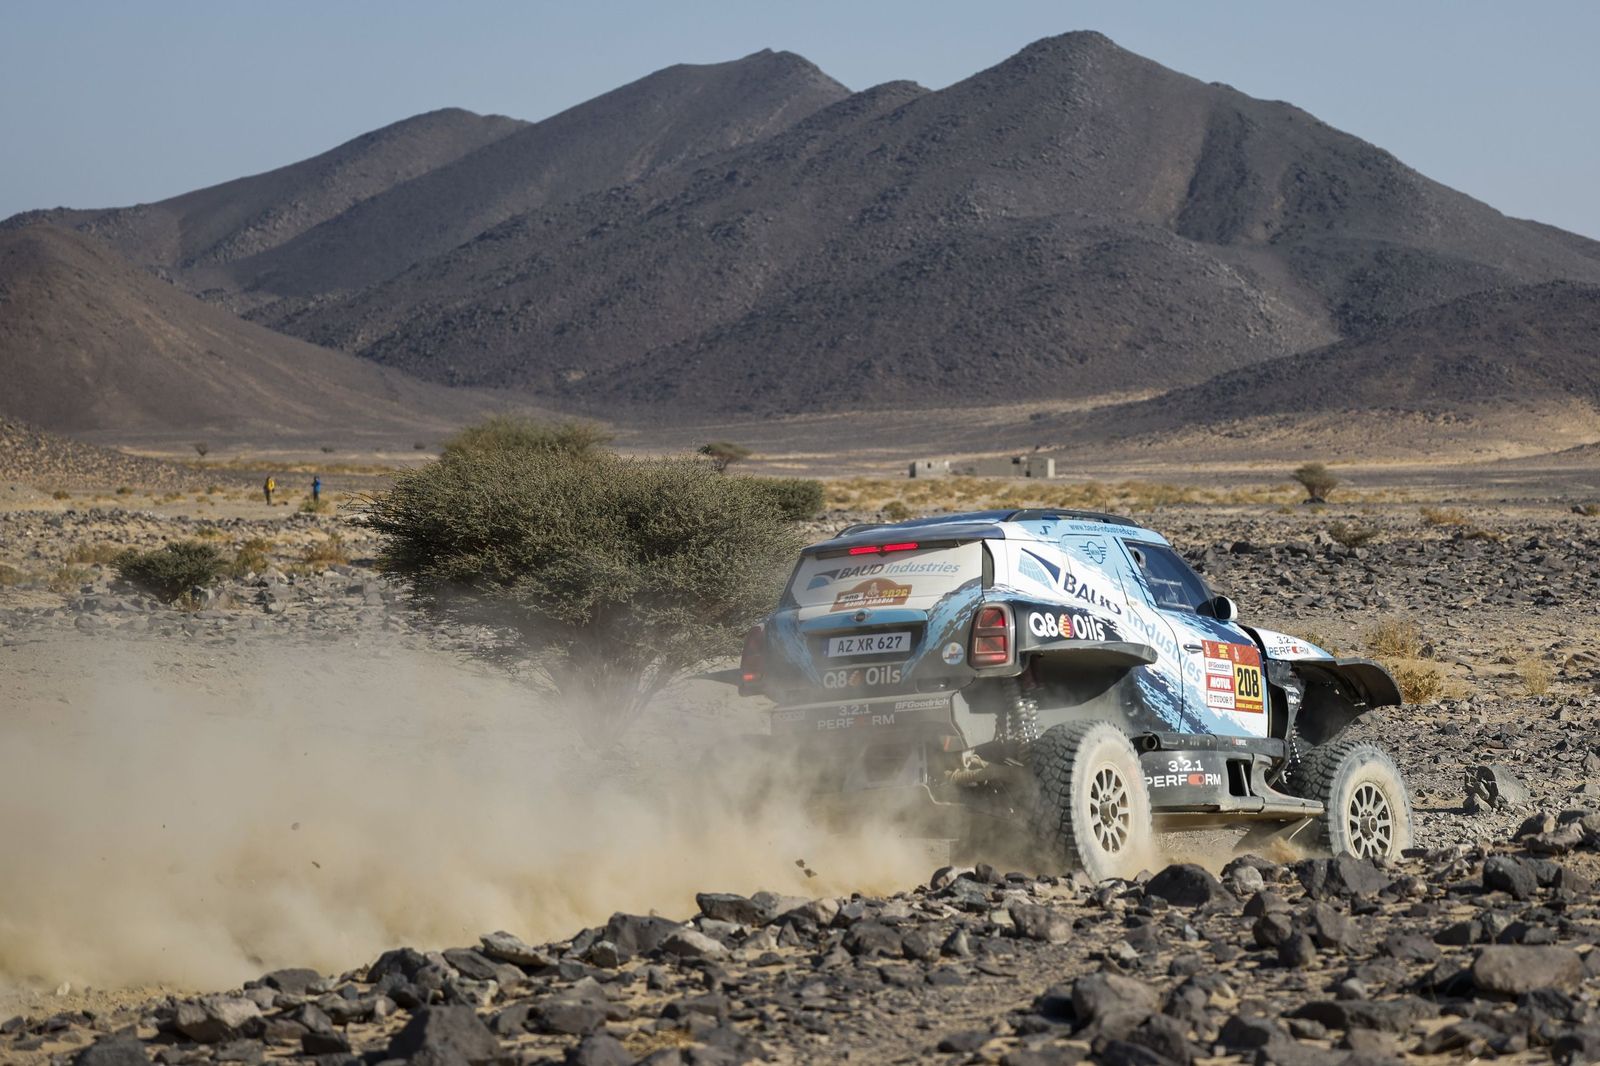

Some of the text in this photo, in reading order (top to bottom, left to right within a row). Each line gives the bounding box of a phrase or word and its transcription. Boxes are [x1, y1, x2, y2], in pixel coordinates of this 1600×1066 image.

[838, 563, 885, 579] BAUD
[1063, 572, 1122, 616] BAUD
[1029, 612, 1106, 641] Q8 Oils
[838, 636, 903, 653] AZ XR 627
[824, 665, 901, 688] Q8 Oils
[1210, 676, 1232, 690] MOTUL
[1237, 667, 1260, 698] 208
[839, 703, 871, 716] 3.2.1
[894, 698, 950, 711] BFGoodrich
[1168, 760, 1204, 772] 3.2.1
